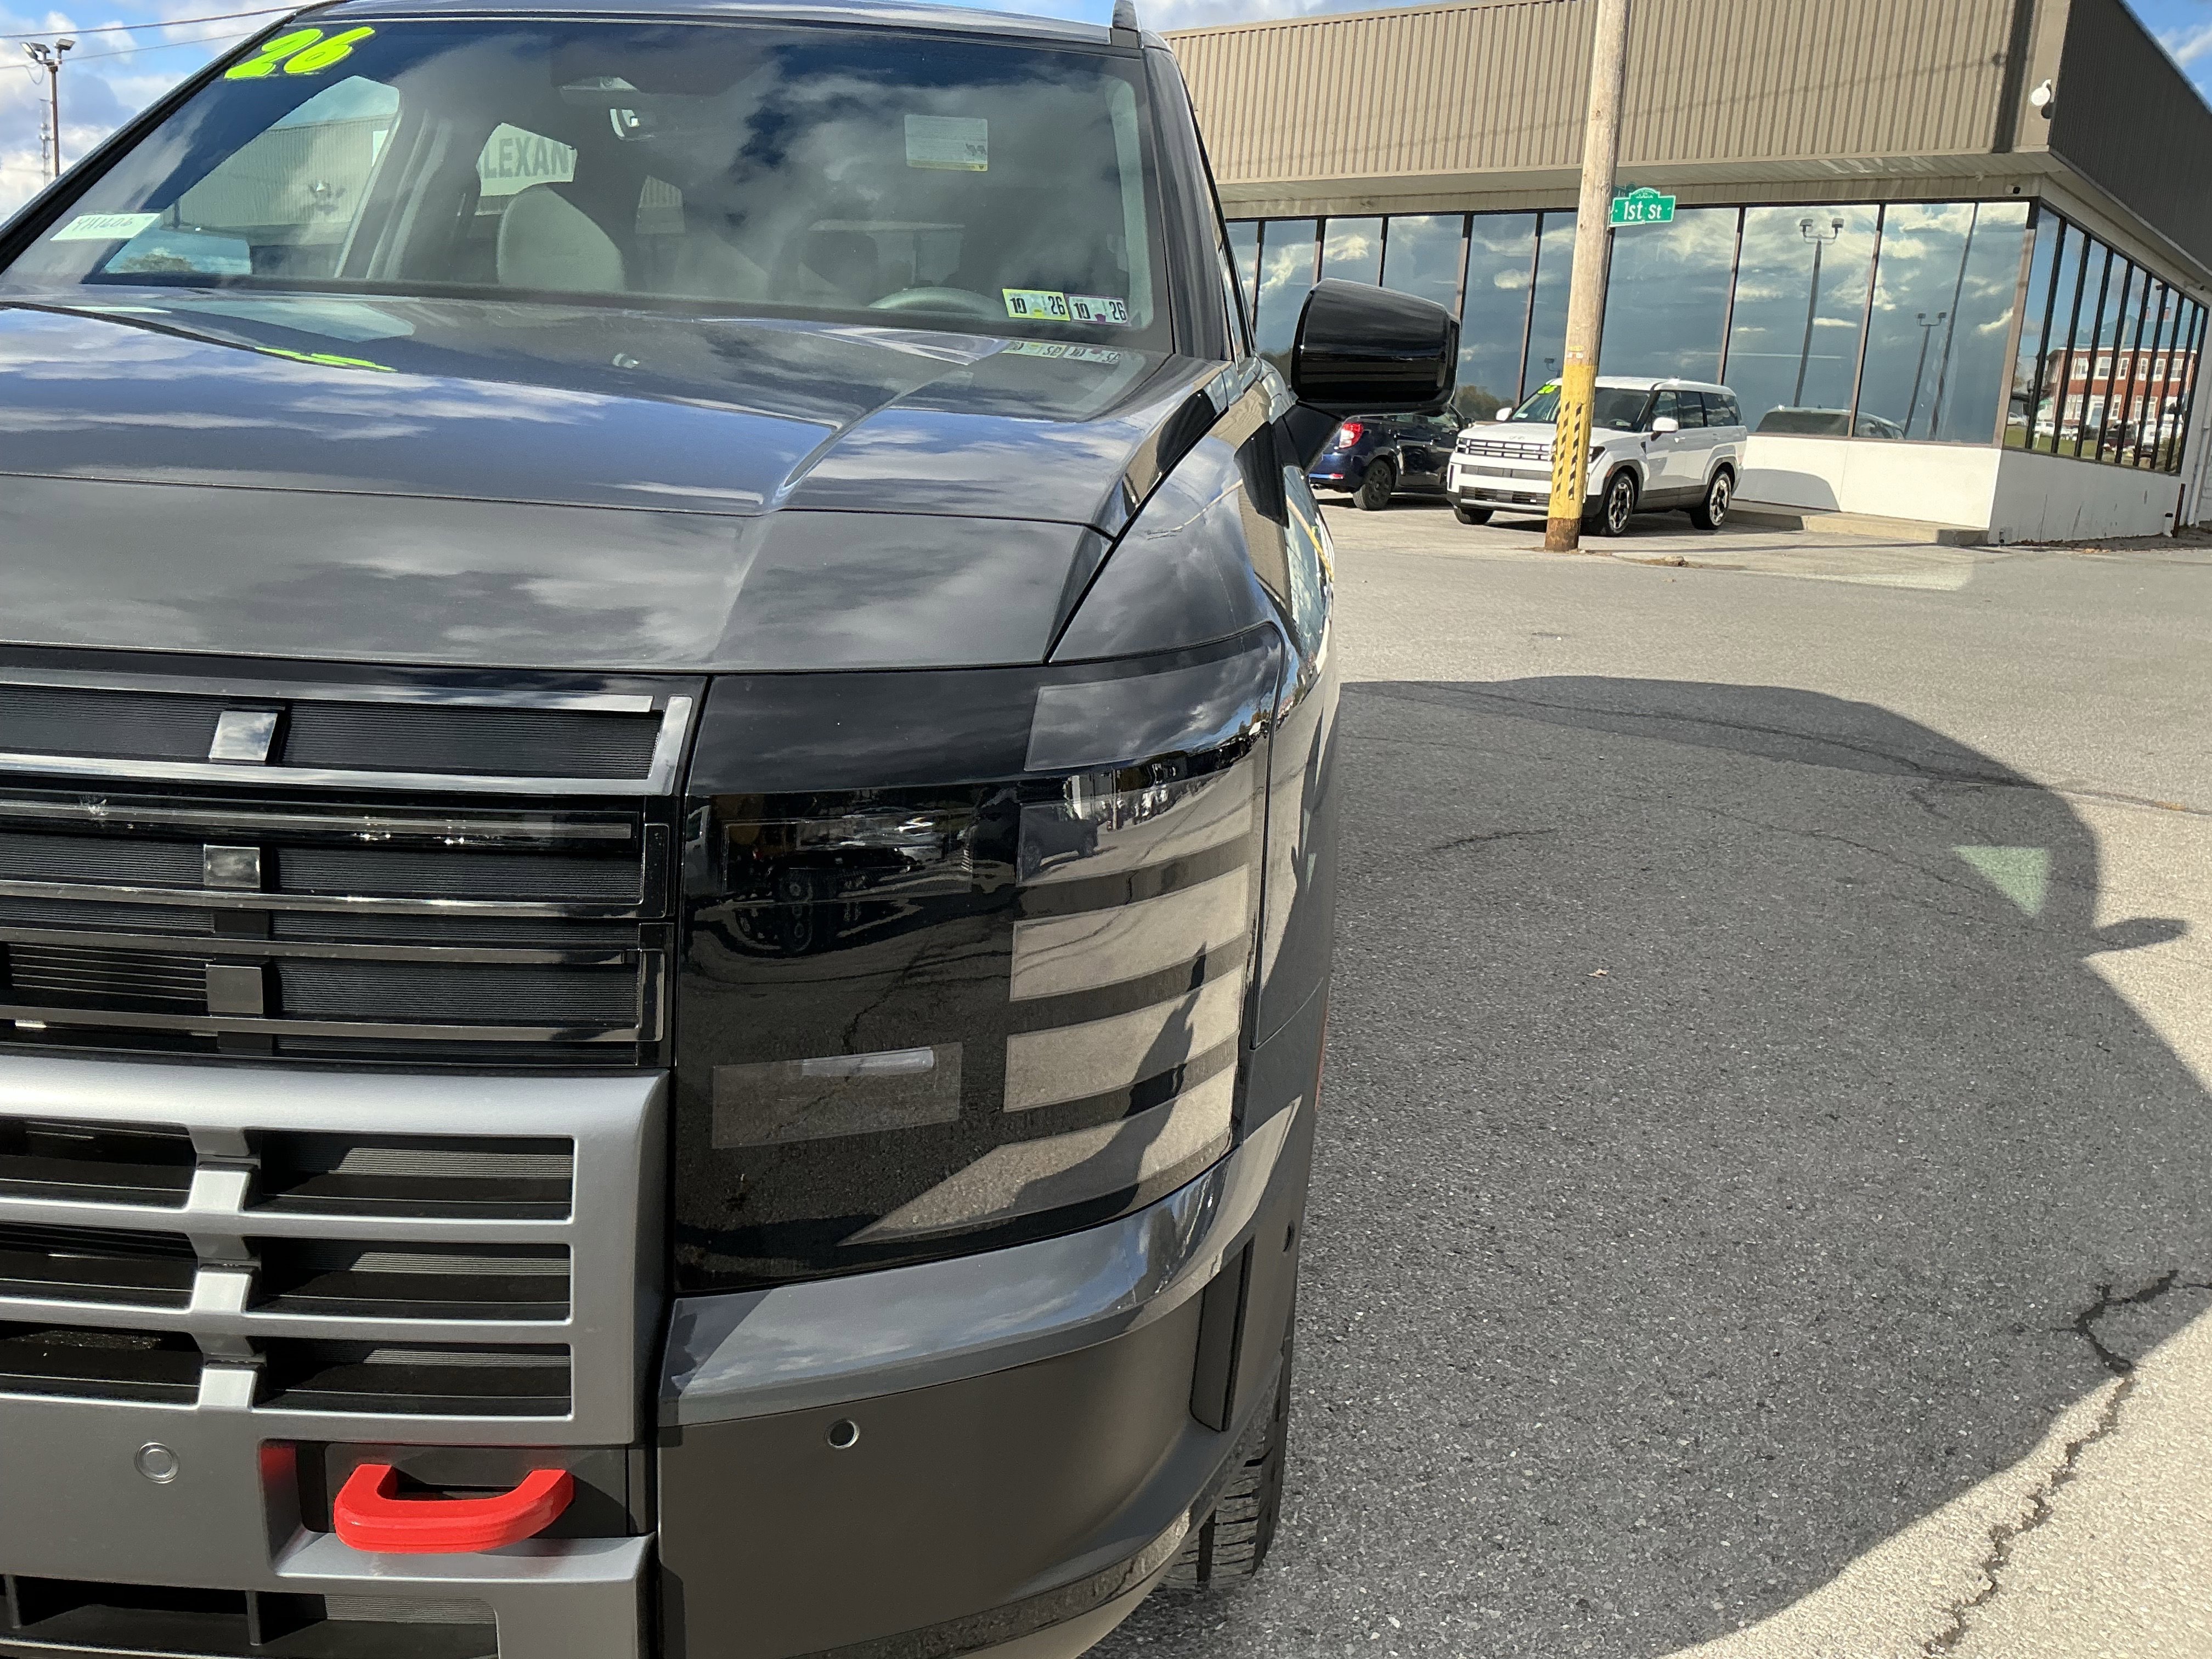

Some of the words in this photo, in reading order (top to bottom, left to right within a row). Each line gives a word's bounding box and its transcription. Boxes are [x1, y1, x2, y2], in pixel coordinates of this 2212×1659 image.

[224, 26, 375, 80] 26
[484, 137, 569, 179] LEXAN
[1623, 200, 1644, 220] 1st
[1647, 204, 1662, 219] St
[1009, 297, 1028, 314] 10
[1048, 296, 1066, 315] 26
[1073, 302, 1091, 319] 10
[1109, 301, 1127, 321] 26
